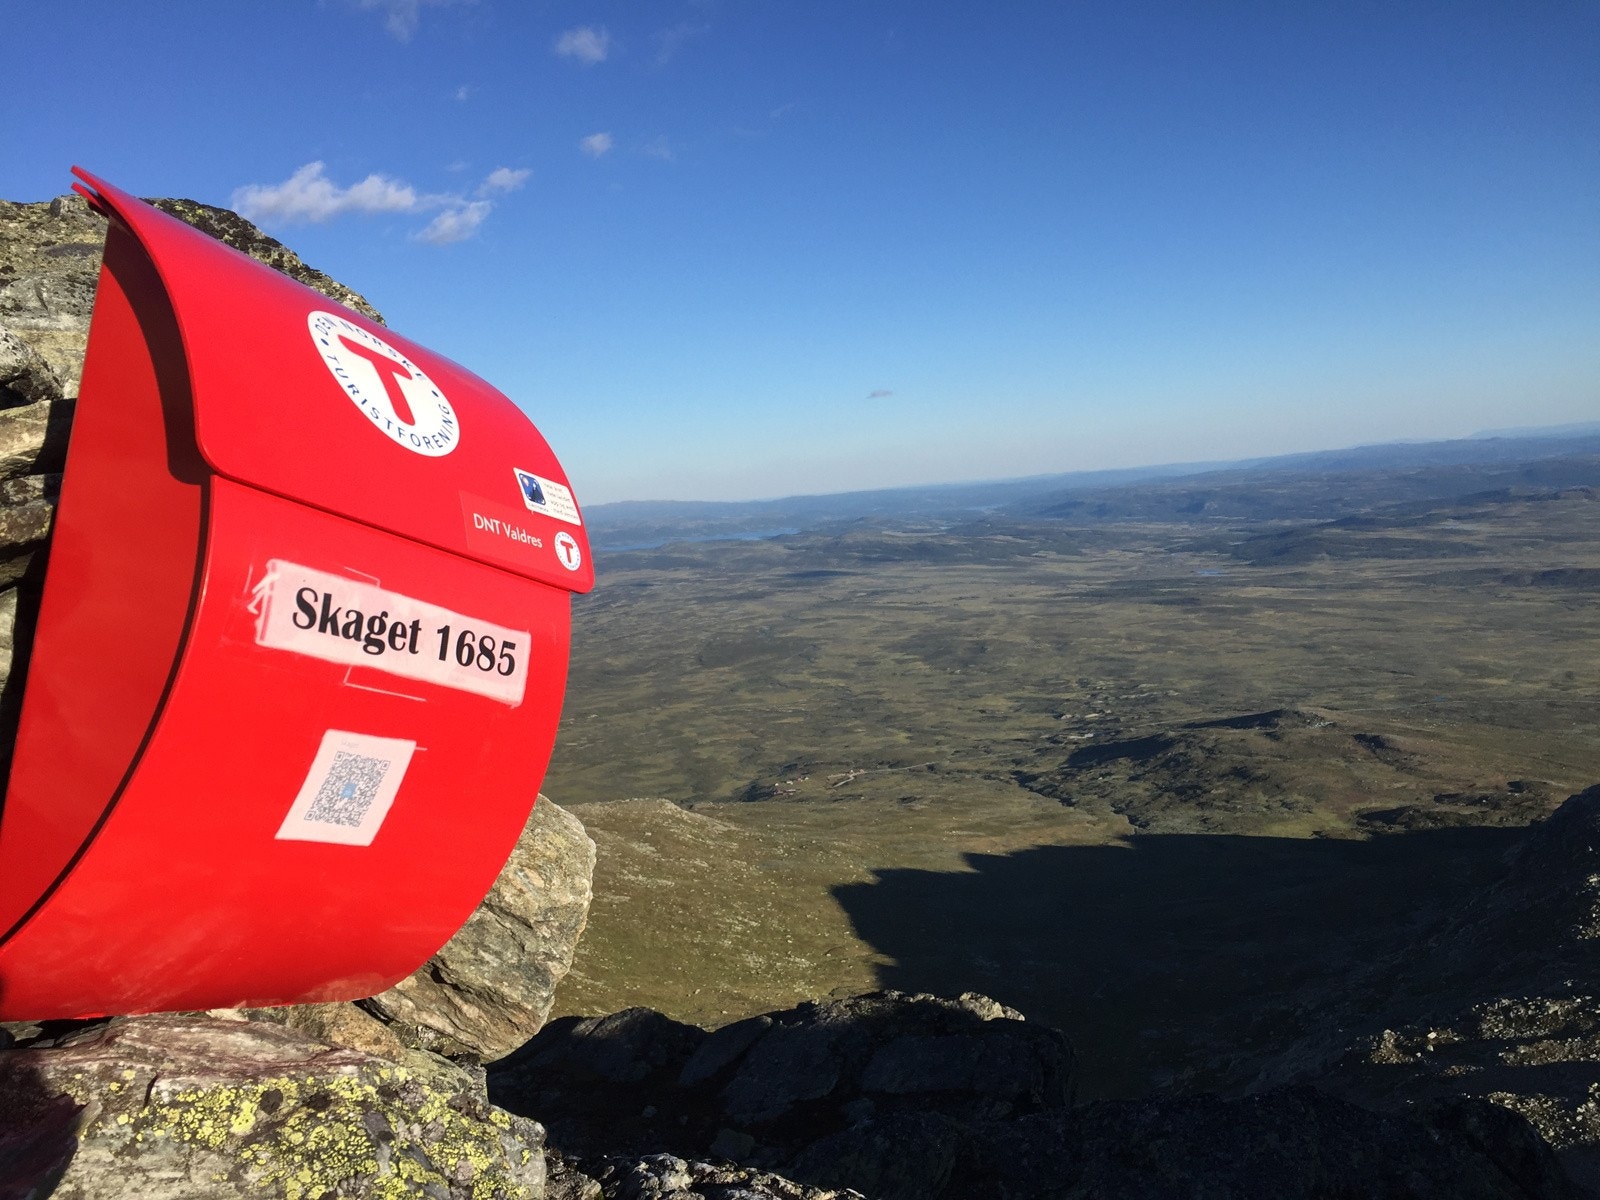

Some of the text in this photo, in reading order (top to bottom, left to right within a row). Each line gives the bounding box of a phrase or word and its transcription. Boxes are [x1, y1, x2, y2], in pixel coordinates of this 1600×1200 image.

[314, 316, 337, 336] DEN
[327, 354, 454, 450] TURISTFORENING
[473, 512, 543, 548] DNT Valdres
[292, 587, 516, 677] Skaget 1685
